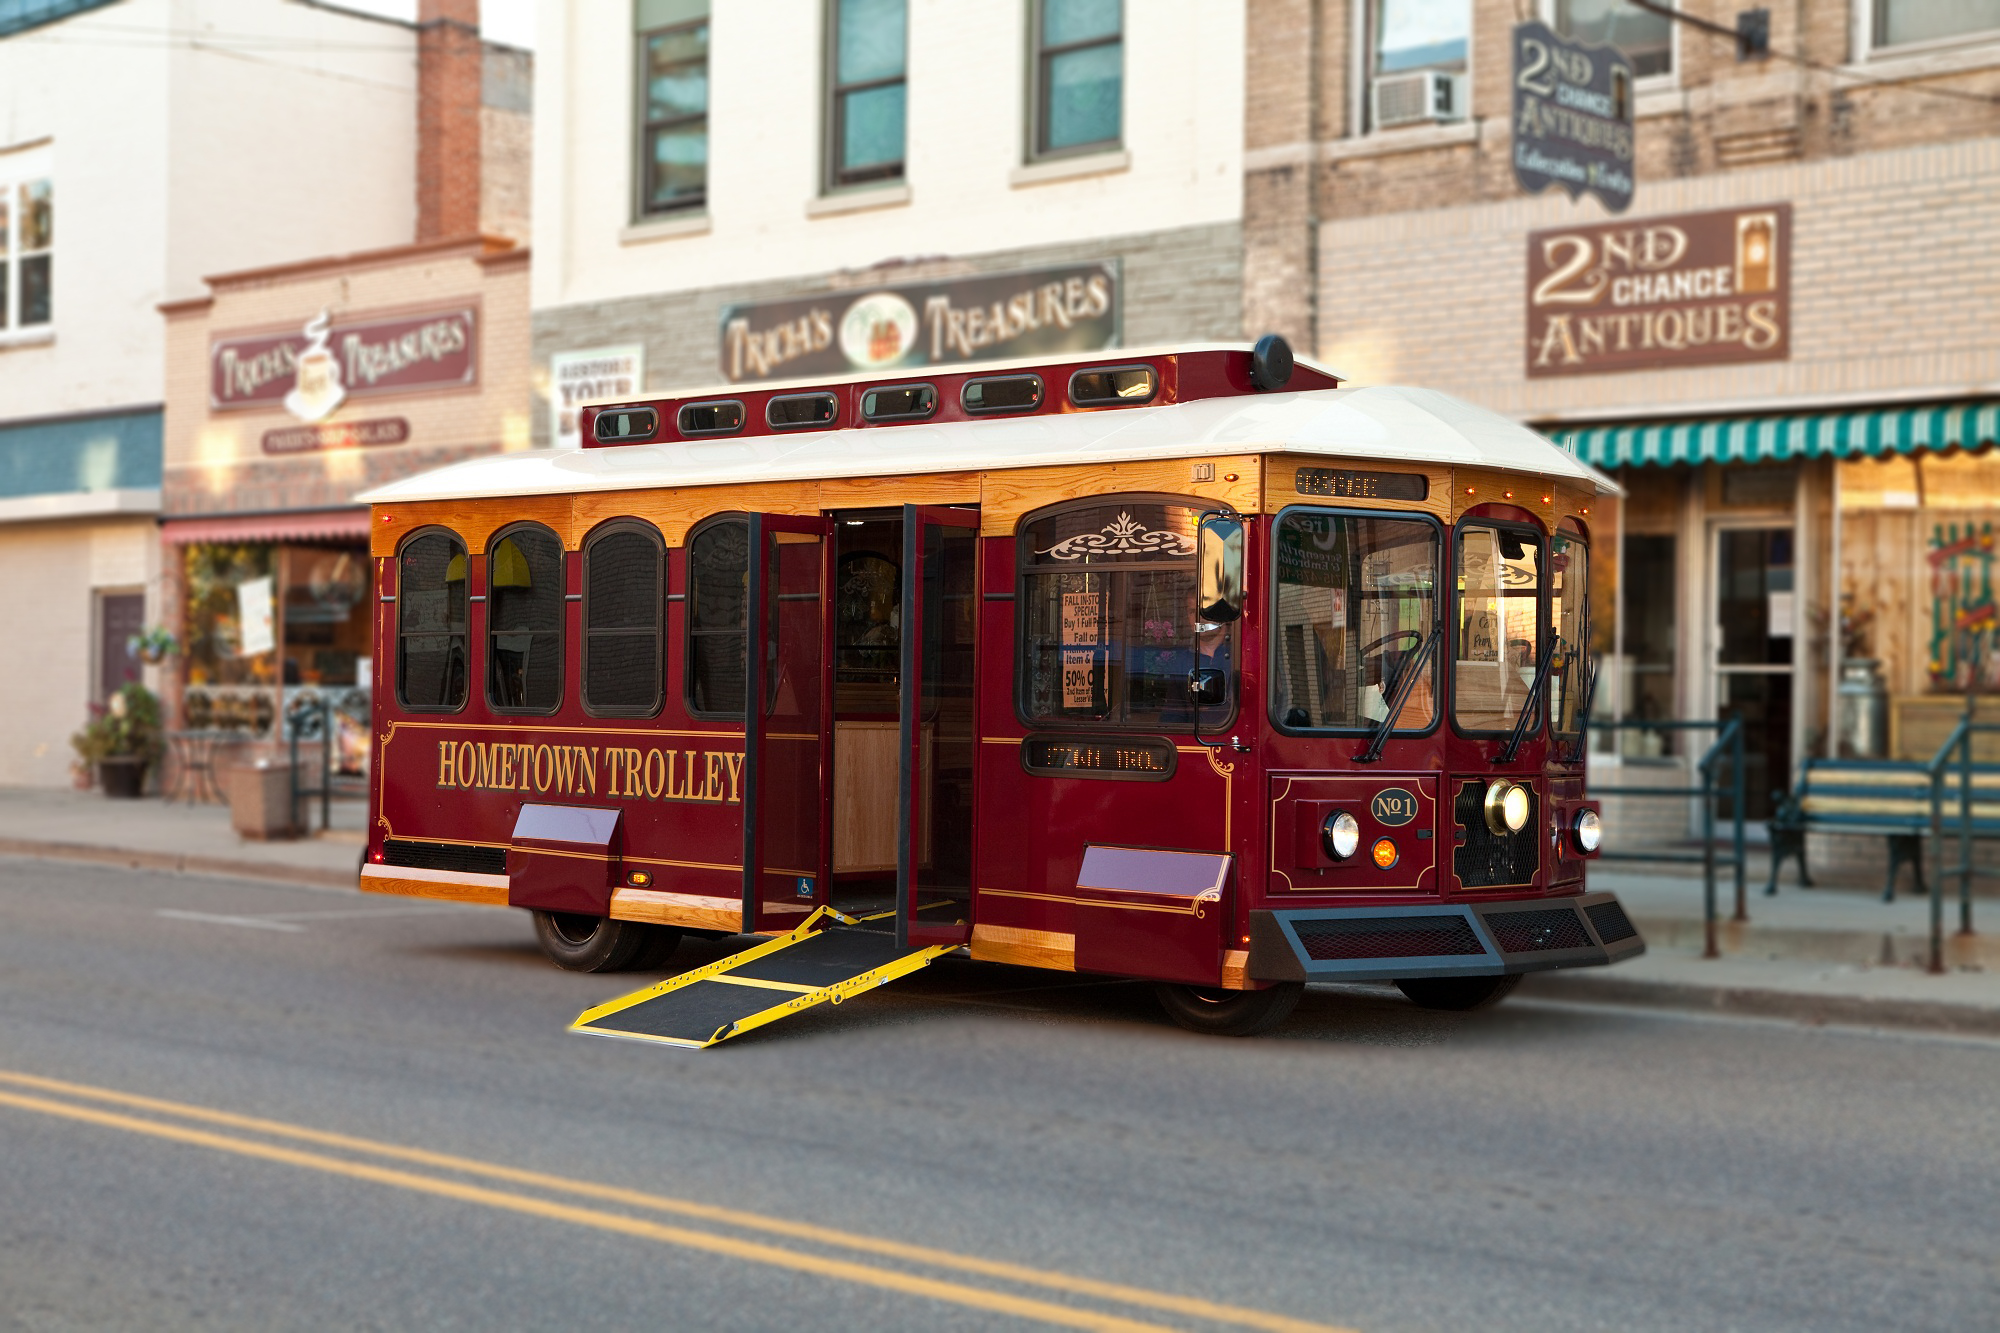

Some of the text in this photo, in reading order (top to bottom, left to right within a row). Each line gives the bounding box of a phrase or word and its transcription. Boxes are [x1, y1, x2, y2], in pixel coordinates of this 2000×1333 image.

[1518, 39, 1593, 96] 2ND
[1519, 97, 1632, 162] ANTIQUES
[1533, 225, 1688, 306] 2ND
[1612, 266, 1733, 306] CHANCE
[925, 275, 1109, 360] TREASURES
[1531, 301, 1780, 366] ANTIQUES
[344, 320, 464, 386] TREASURES
[1064, 595, 1079, 606] FALL
[1064, 618, 1076, 631] Buy
[1081, 618, 1093, 628] Full
[1074, 606, 1098, 617] SPECIAL
[1066, 654, 1091, 665] Item &
[1074, 632, 1098, 643] Fall or
[1065, 670, 1086, 687] 50%
[437, 740, 745, 803] HOMETOWN TROLLEY
